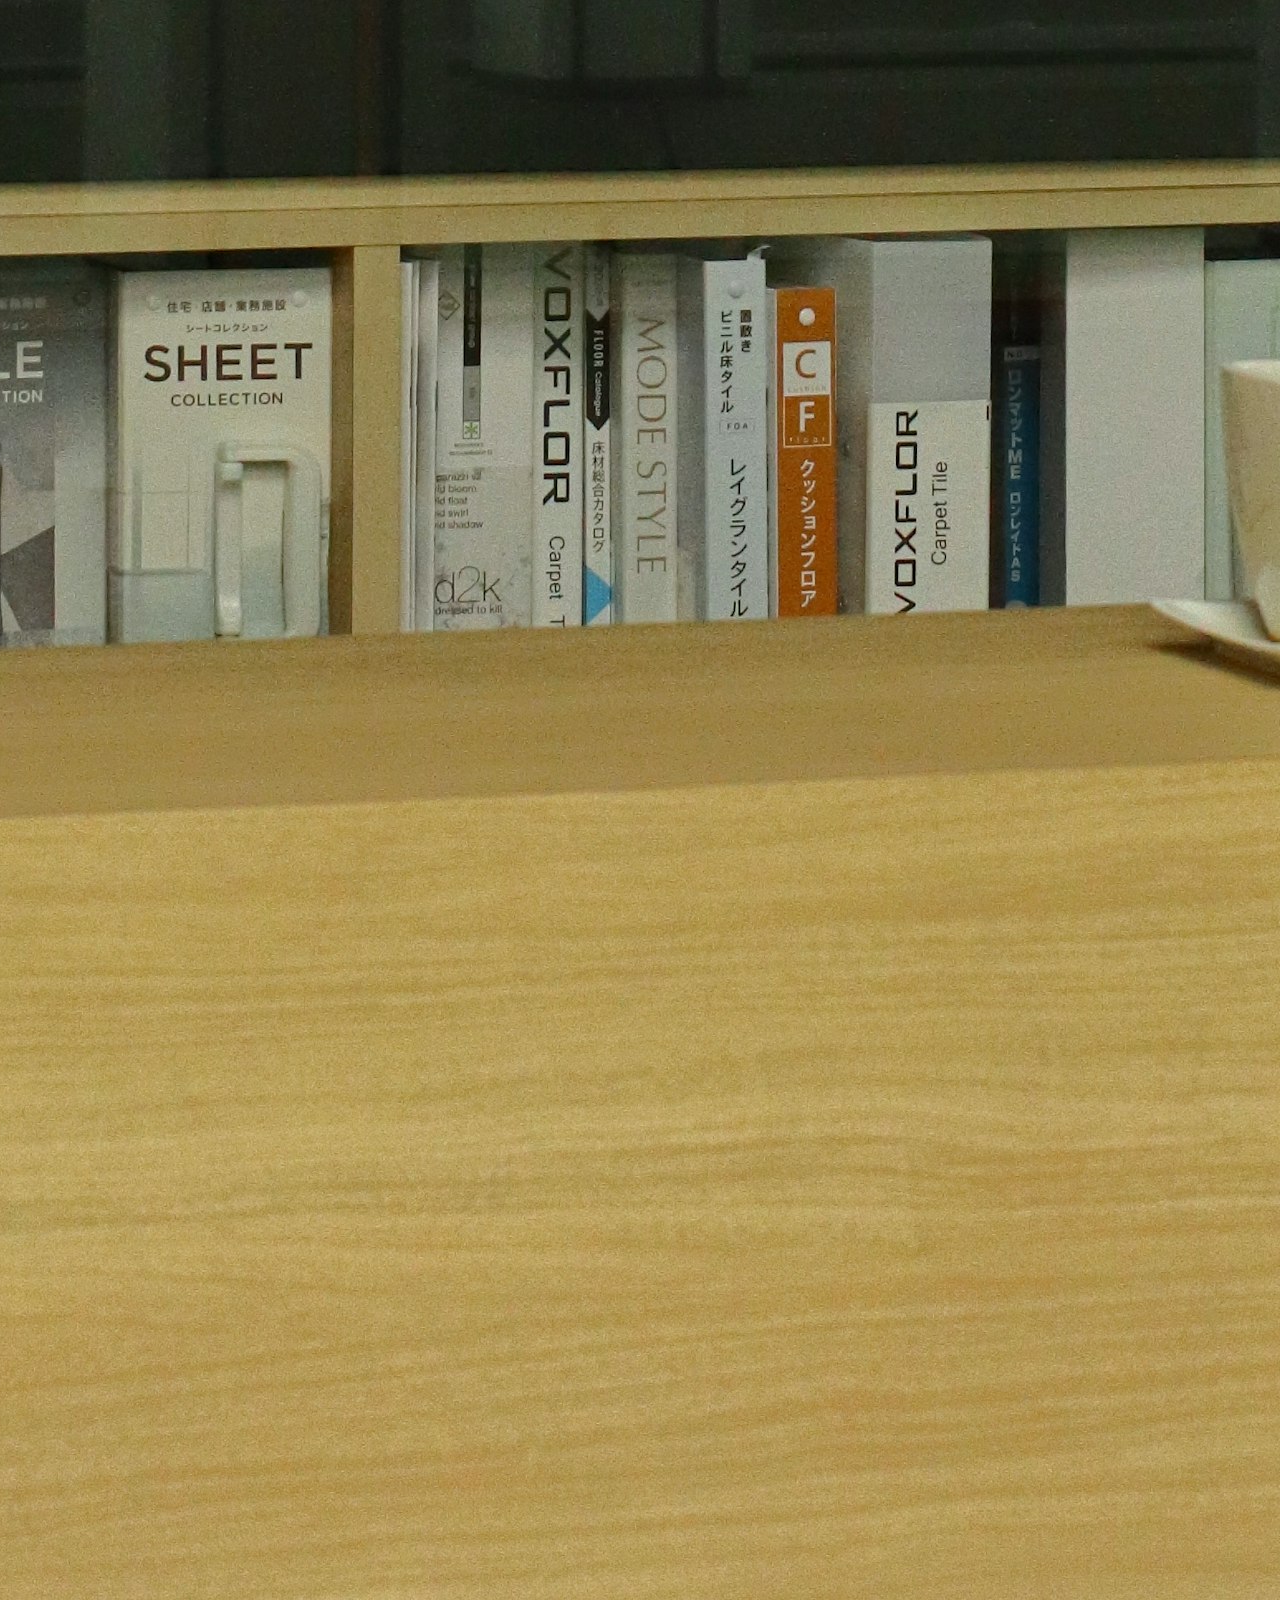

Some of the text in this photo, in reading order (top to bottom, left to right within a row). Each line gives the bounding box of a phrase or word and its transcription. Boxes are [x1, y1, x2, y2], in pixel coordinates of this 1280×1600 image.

[144, 341, 312, 384] SHEET
[170, 392, 284, 407] COLLECTION
[720, 309, 735, 414] ビニル床タイル
[794, 349, 819, 381] C
[634, 316, 668, 574] MODE STYLE
[798, 401, 816, 433] F
[591, 447, 605, 554] 床材総合カタログ
[728, 459, 750, 619] レイグランタイル
[799, 460, 818, 608] クッションフロア
[930, 460, 950, 566] Carpet Tile
[433, 566, 502, 604] d2k
[547, 536, 566, 601] Carpet
